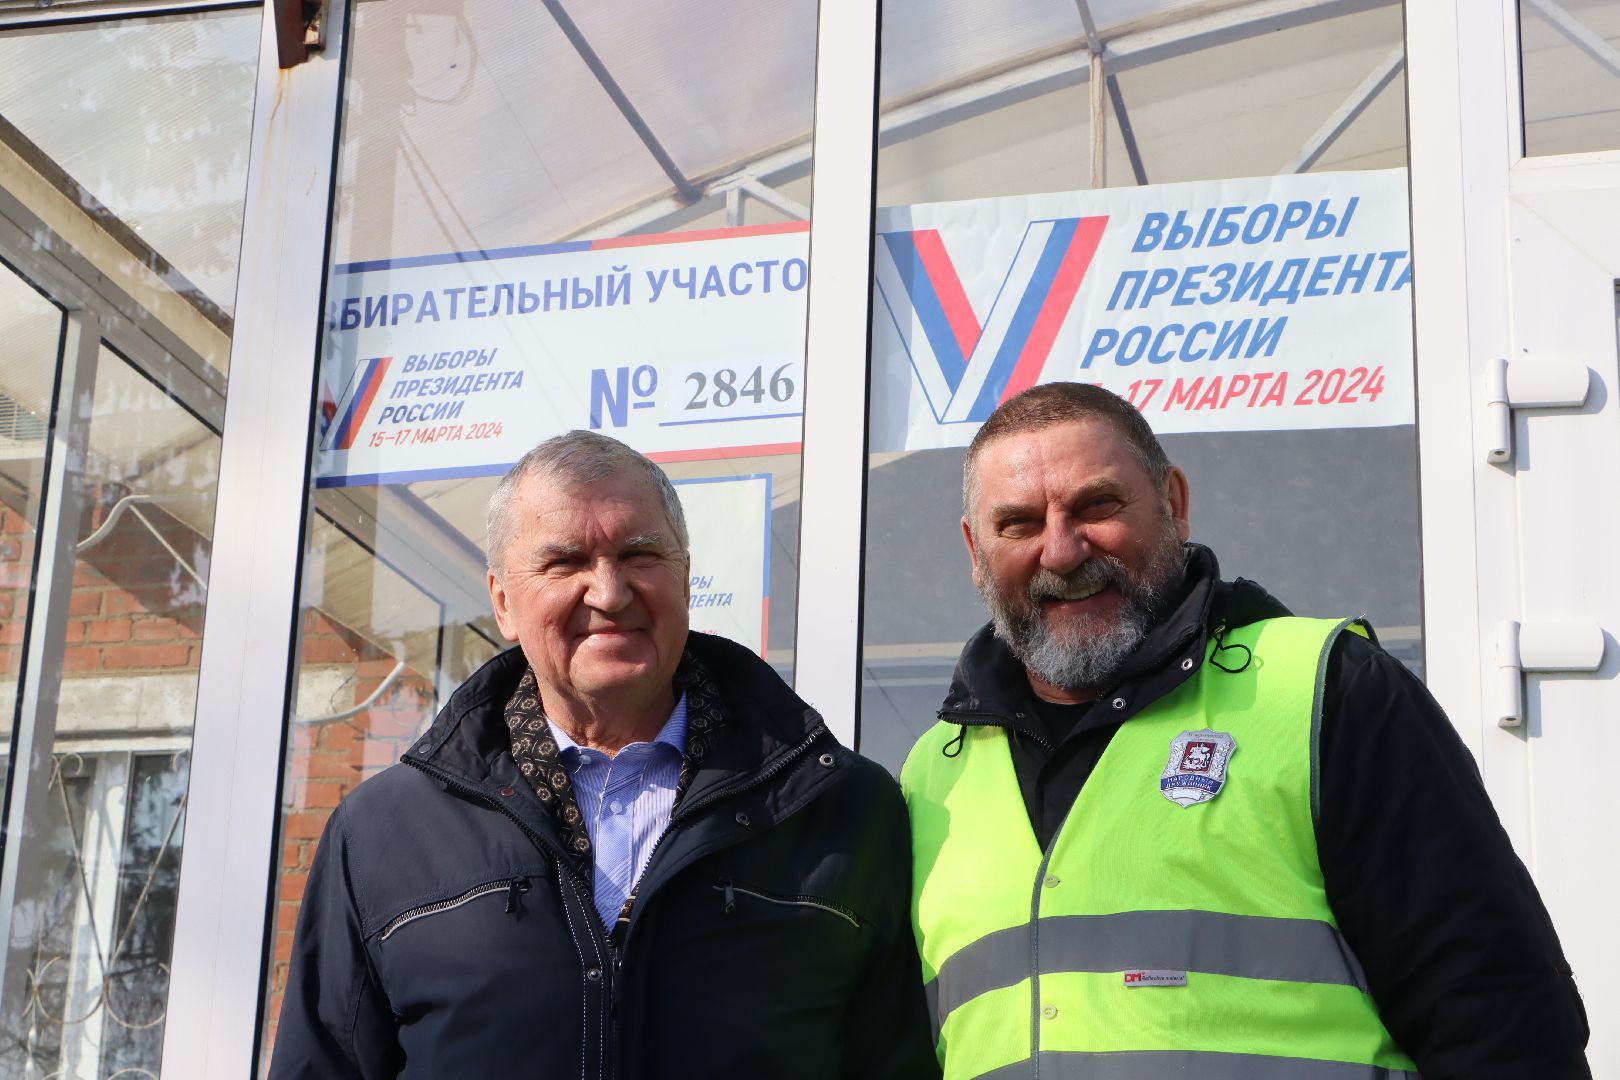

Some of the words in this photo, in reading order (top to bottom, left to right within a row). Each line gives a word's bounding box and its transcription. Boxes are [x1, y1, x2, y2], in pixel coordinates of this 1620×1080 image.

[1131, 196, 1360, 253] ВЫБОРЫ
[647, 257, 808, 303] УЧАСТО
[401, 348, 498, 373] ВЫБОРЫ
[1080, 315, 1288, 369] РОССИИ
[389, 370, 525, 400] ПРЕЗИДЕНТА
[684, 362, 796, 411] 2846
[1163, 370, 1291, 412] МАРТА
[1293, 365, 1385, 407] 2024
[377, 400, 465, 425] РОССИИ
[411, 425, 464, 445] МАРТА
[465, 421, 504, 440] 2024
